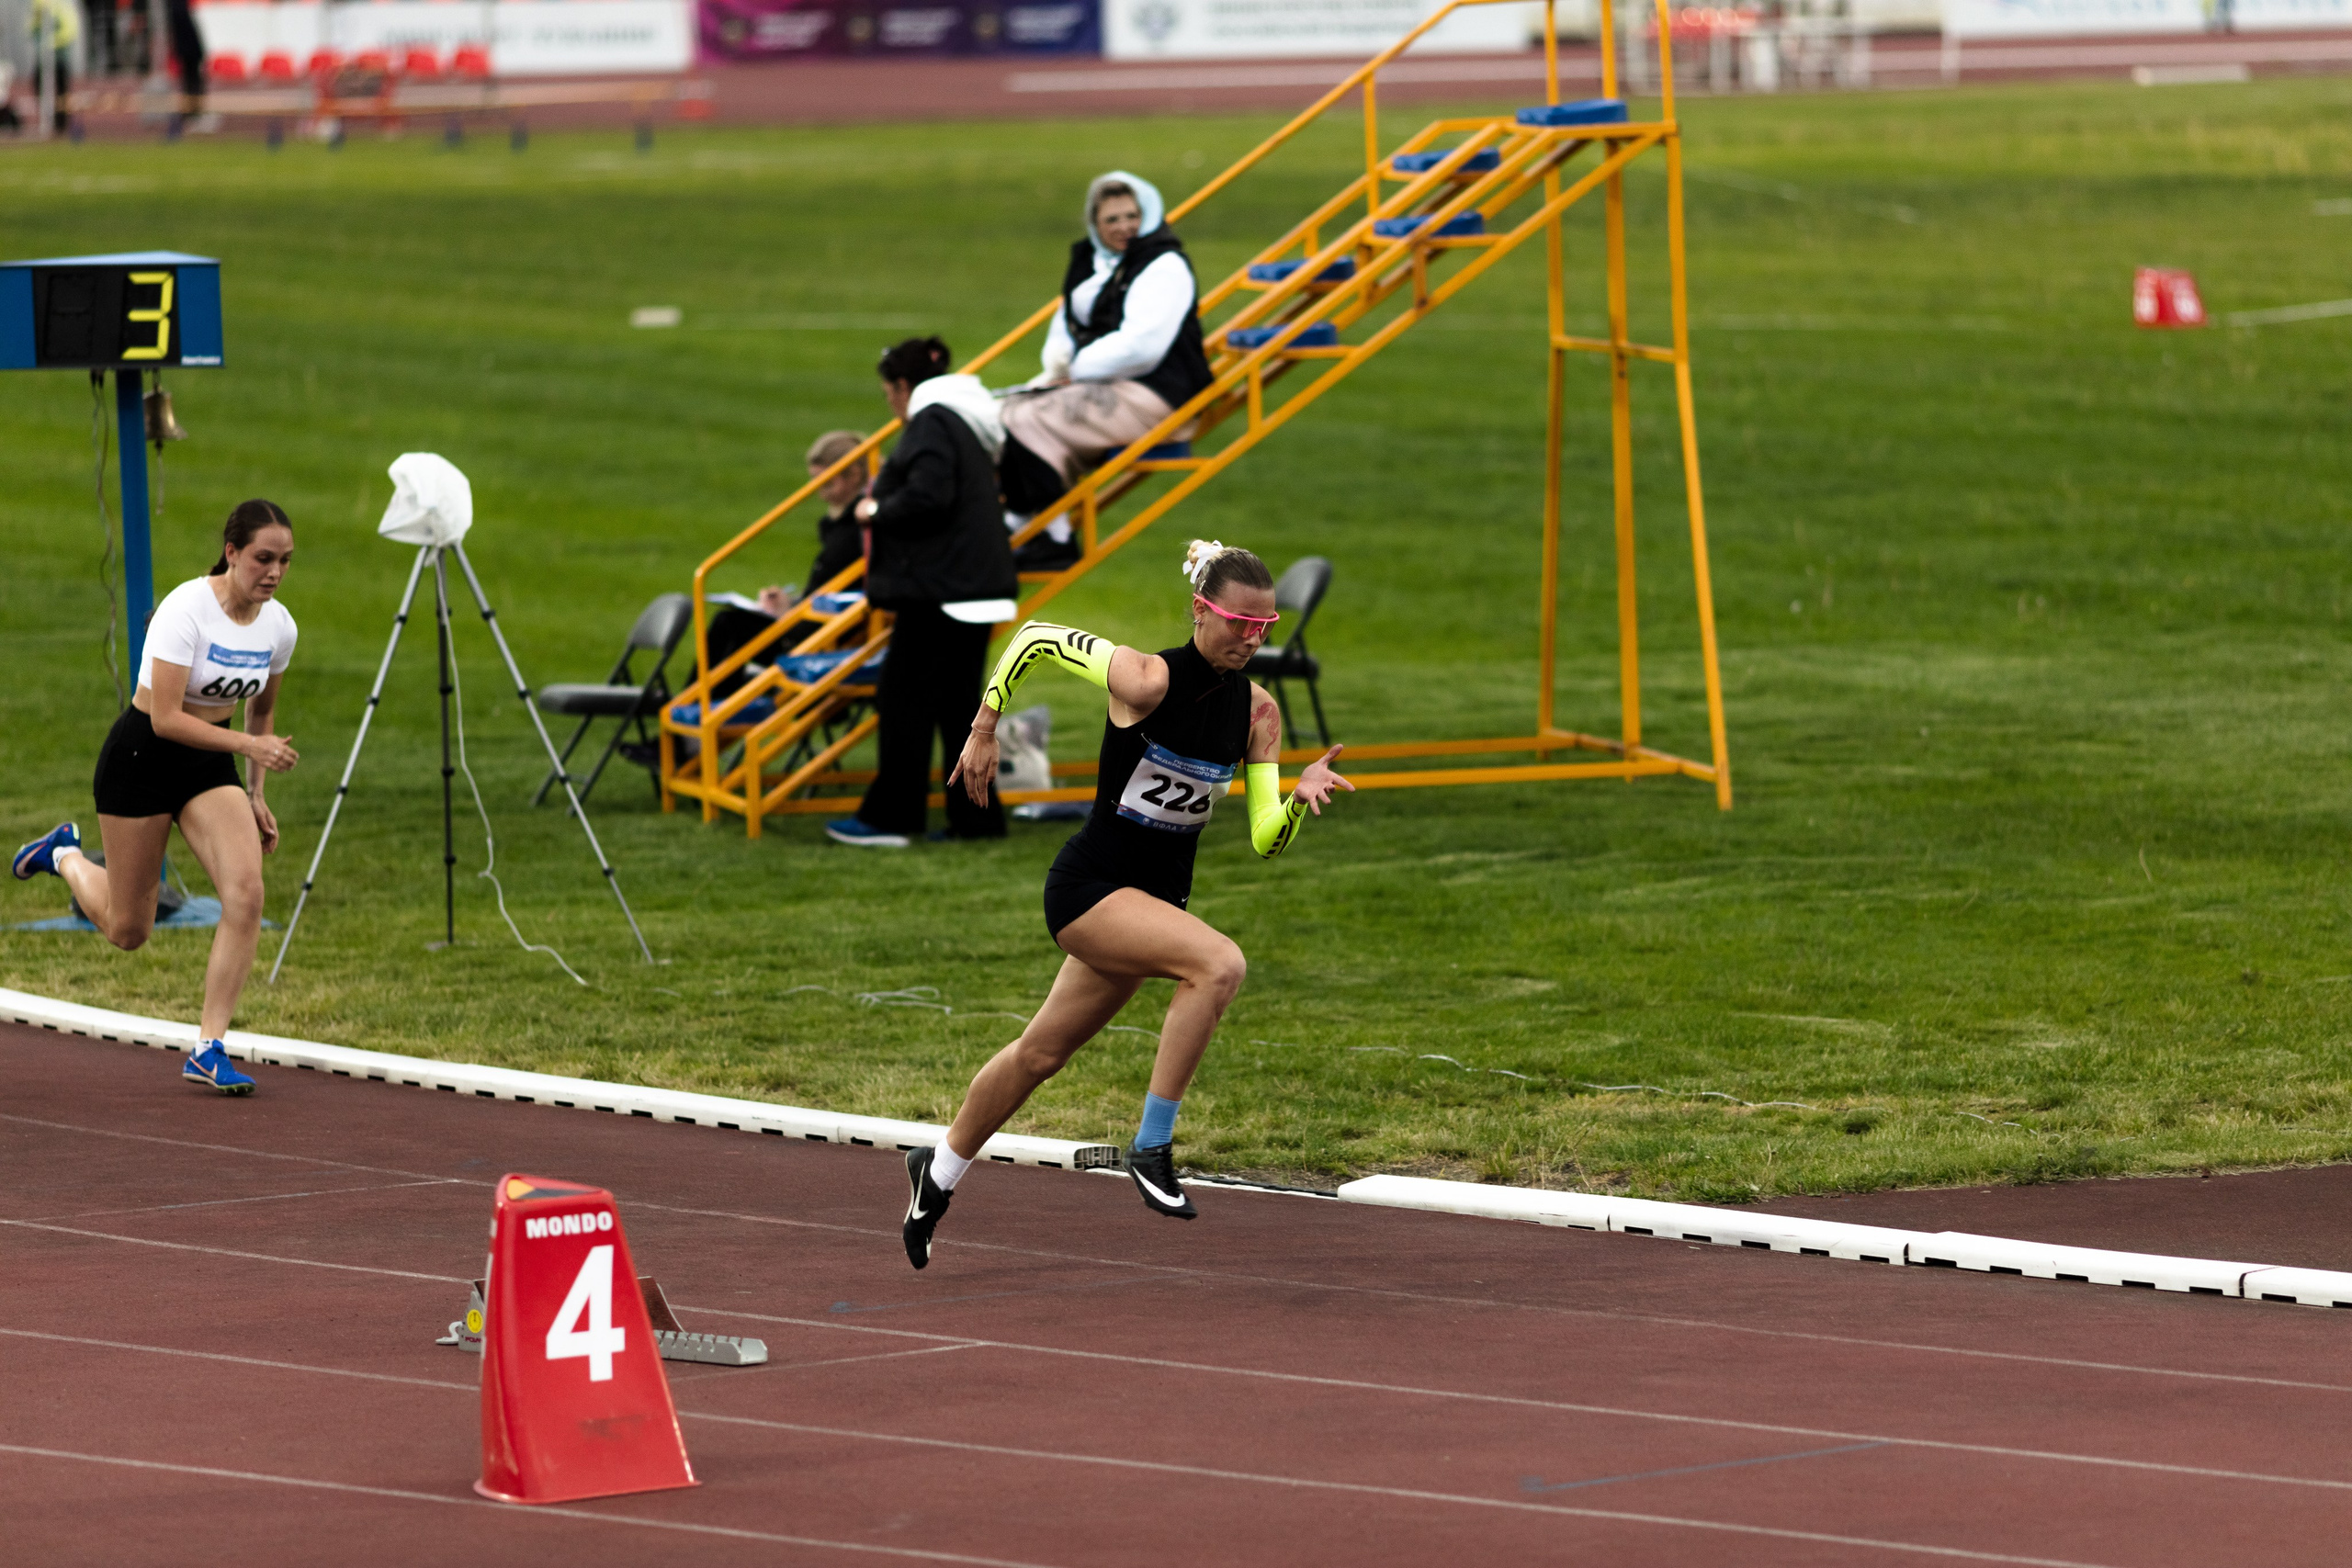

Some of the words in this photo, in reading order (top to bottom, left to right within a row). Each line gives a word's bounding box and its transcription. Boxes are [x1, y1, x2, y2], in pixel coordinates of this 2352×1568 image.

[120, 270, 175, 361] 3
[200, 676, 261, 700] 600
[1151, 753, 1210, 778] ФЕДЕРАЛЬНОГО
[1173, 759, 1221, 774] ПЕРВЕНСТВО
[1140, 773, 1214, 815] 226
[1152, 821, 1178, 831] ВФЛА
[525, 1211, 615, 1239] MONDO
[546, 1244, 626, 1382] 4
